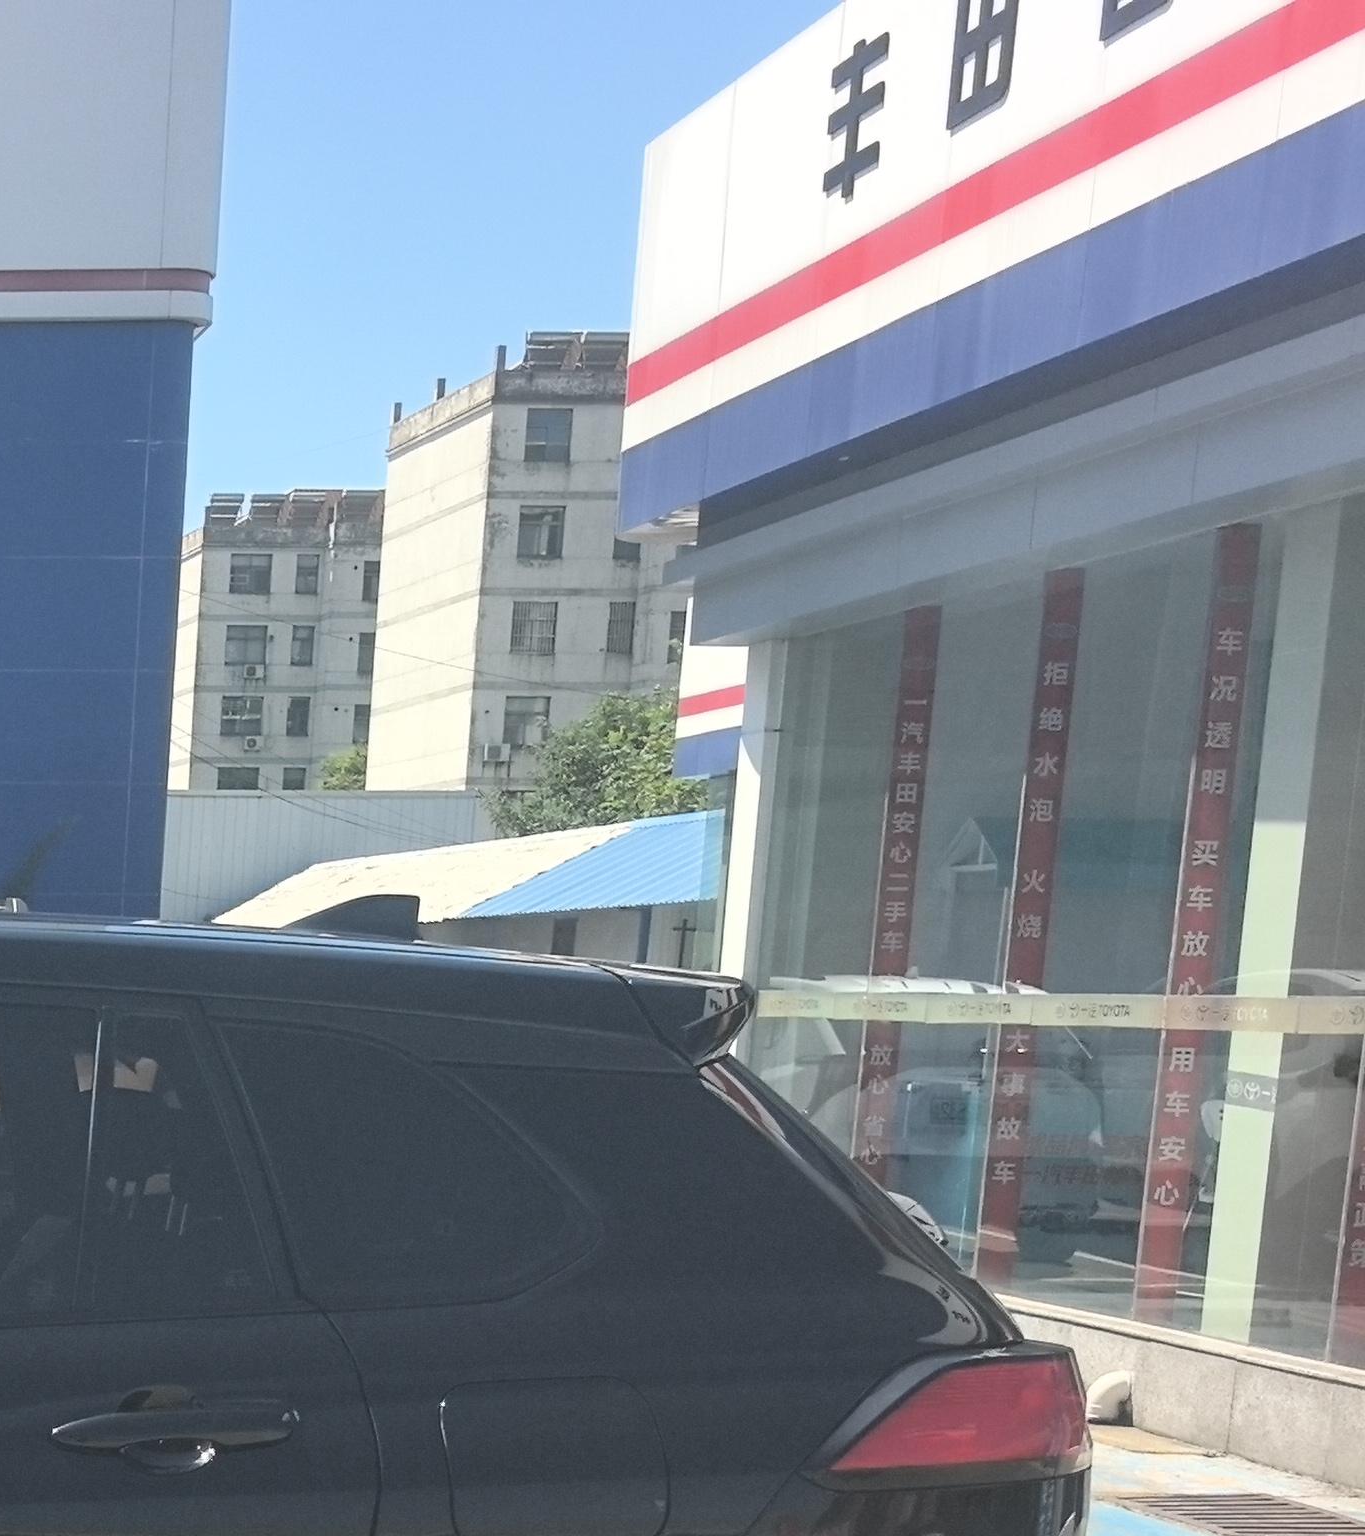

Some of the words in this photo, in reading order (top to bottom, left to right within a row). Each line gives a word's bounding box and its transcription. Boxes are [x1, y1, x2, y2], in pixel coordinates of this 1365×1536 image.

[1027, 661, 1070, 823] 拒绝水泡
[1200, 628, 1244, 795] 车况透明
[880, 699, 928, 952] 一汽丰田安心二手车
[1015, 869, 1046, 939] 火烧
[1177, 838, 1221, 996] 买车放心
[1153, 1046, 1196, 1206] 用车安心
